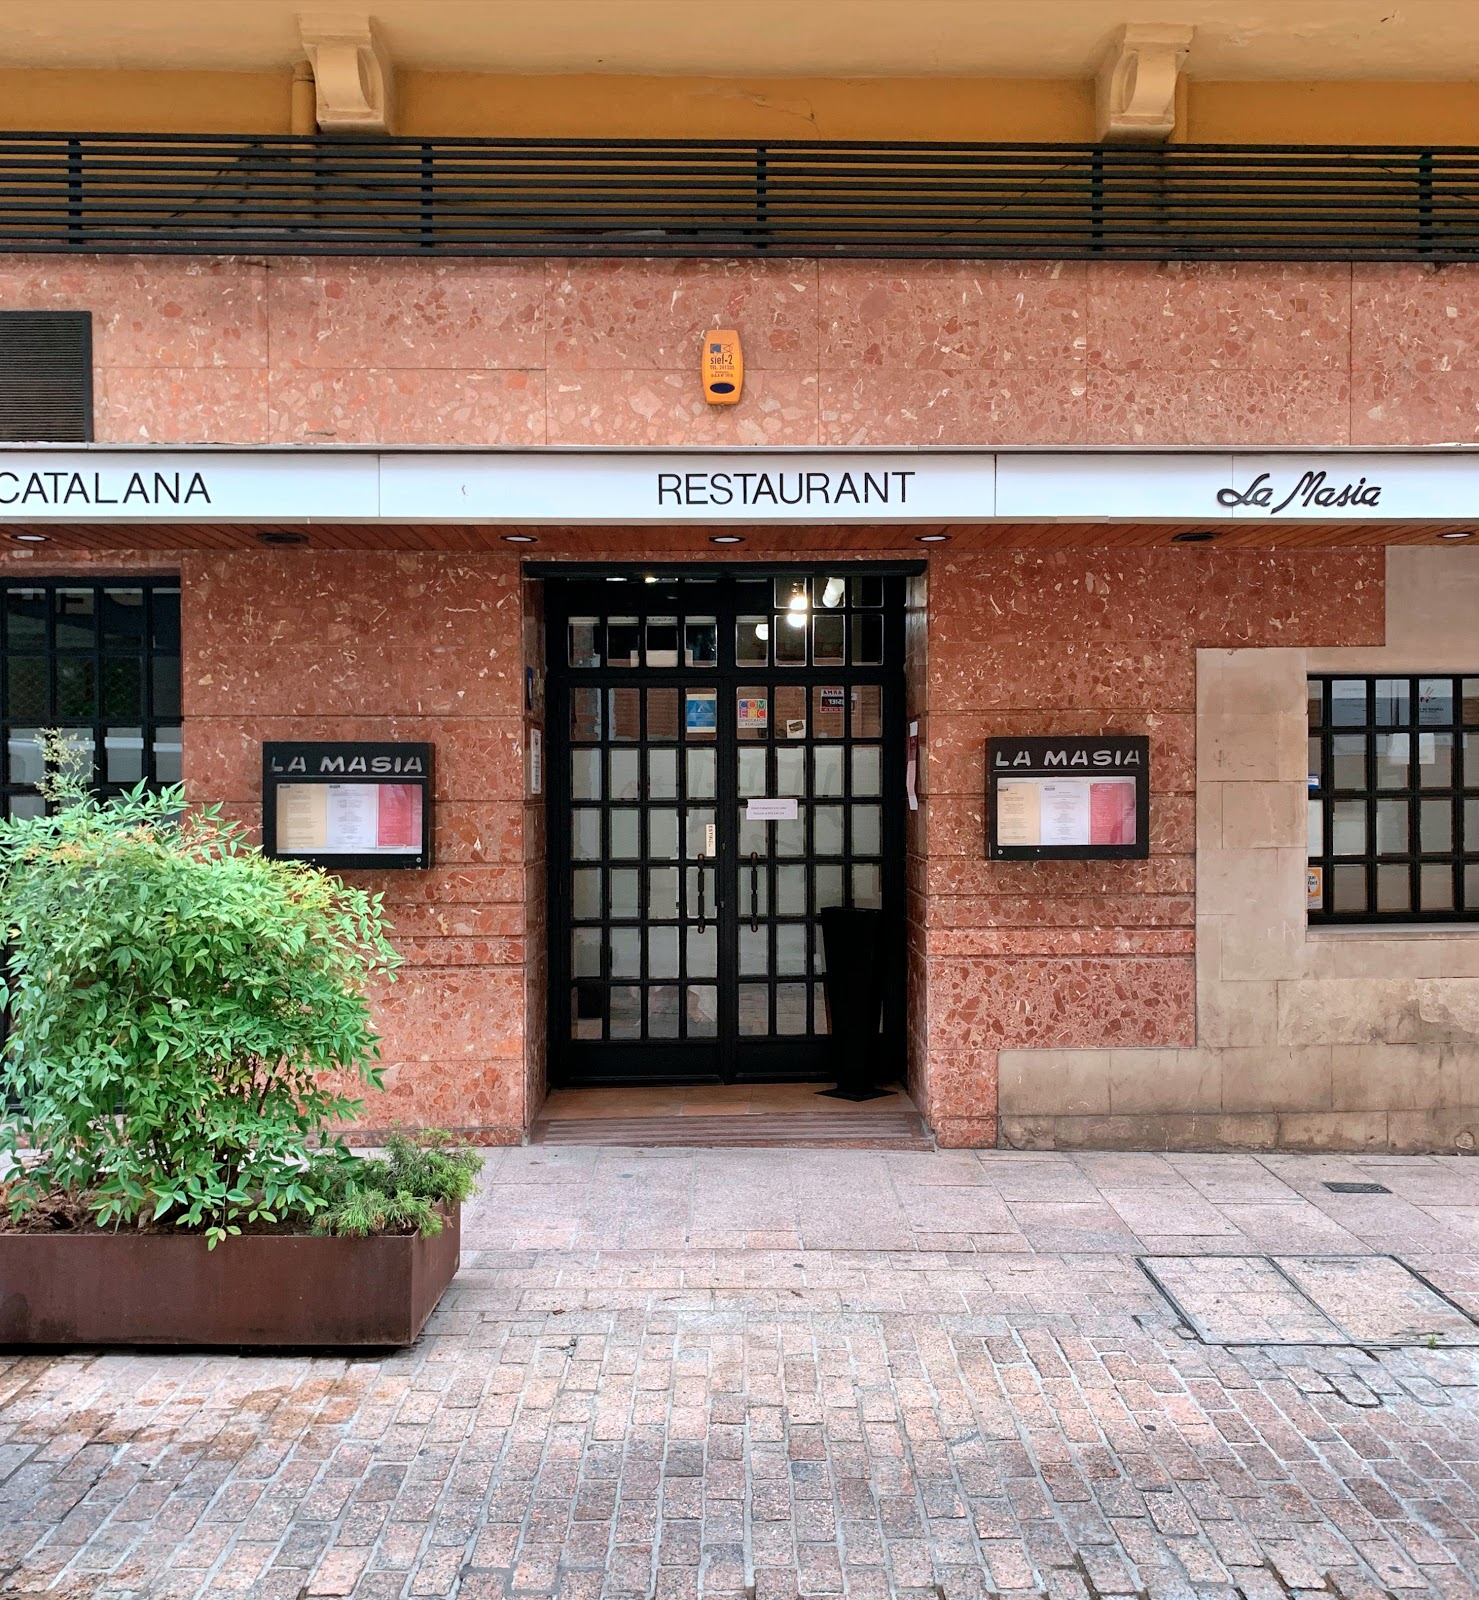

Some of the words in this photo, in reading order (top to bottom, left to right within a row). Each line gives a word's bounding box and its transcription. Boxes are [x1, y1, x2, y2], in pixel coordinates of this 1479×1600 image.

[710, 353, 733, 364] sief-2
[0, 471, 212, 504] CATALANA
[658, 471, 916, 505] RESTAURANT
[1216, 472, 1274, 508] La
[1271, 470, 1382, 515] Masia
[271, 756, 307, 773] LA
[319, 756, 423, 773] MASIA
[995, 750, 1032, 767] LA
[1043, 749, 1141, 766] MASIA
